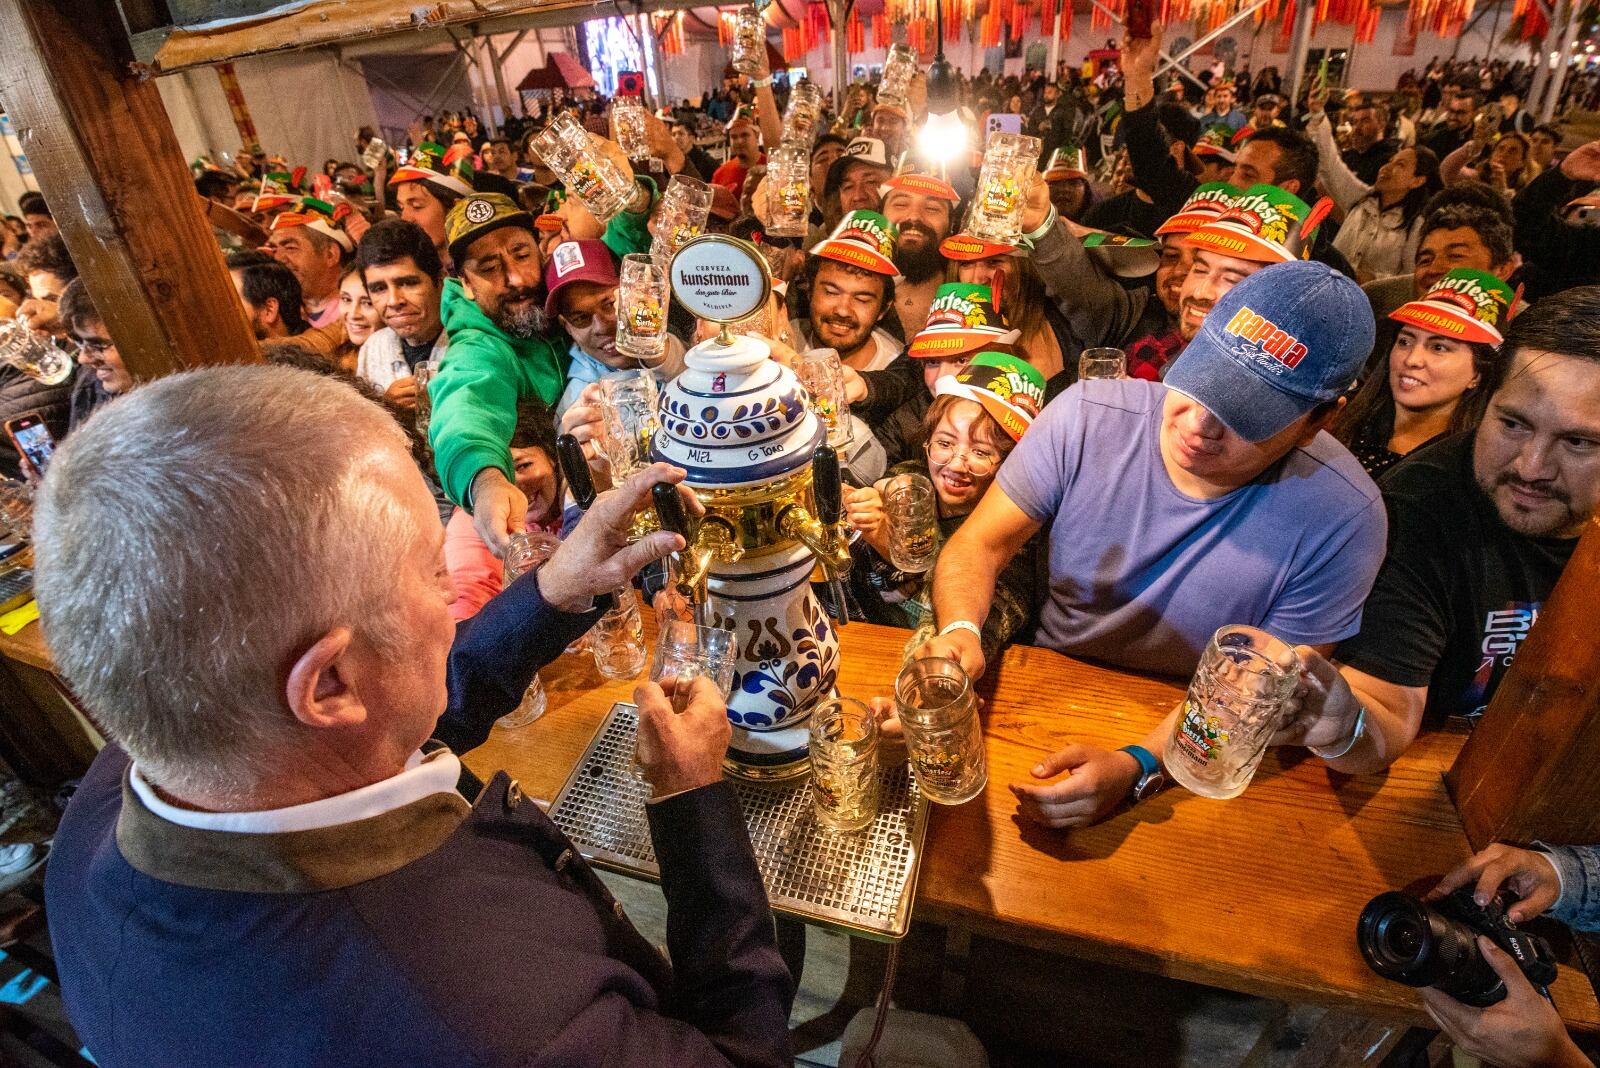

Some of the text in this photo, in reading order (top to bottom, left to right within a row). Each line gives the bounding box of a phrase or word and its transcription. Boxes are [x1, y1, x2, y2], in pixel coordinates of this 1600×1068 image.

[823, 245, 877, 267] unstmann
[680, 269, 750, 287] kunstmann
[703, 301, 732, 310] VALDIVIA
[1004, 411, 1026, 437] kun
[687, 449, 713, 463] MIEL
[1508, 937, 1525, 961] SONY
